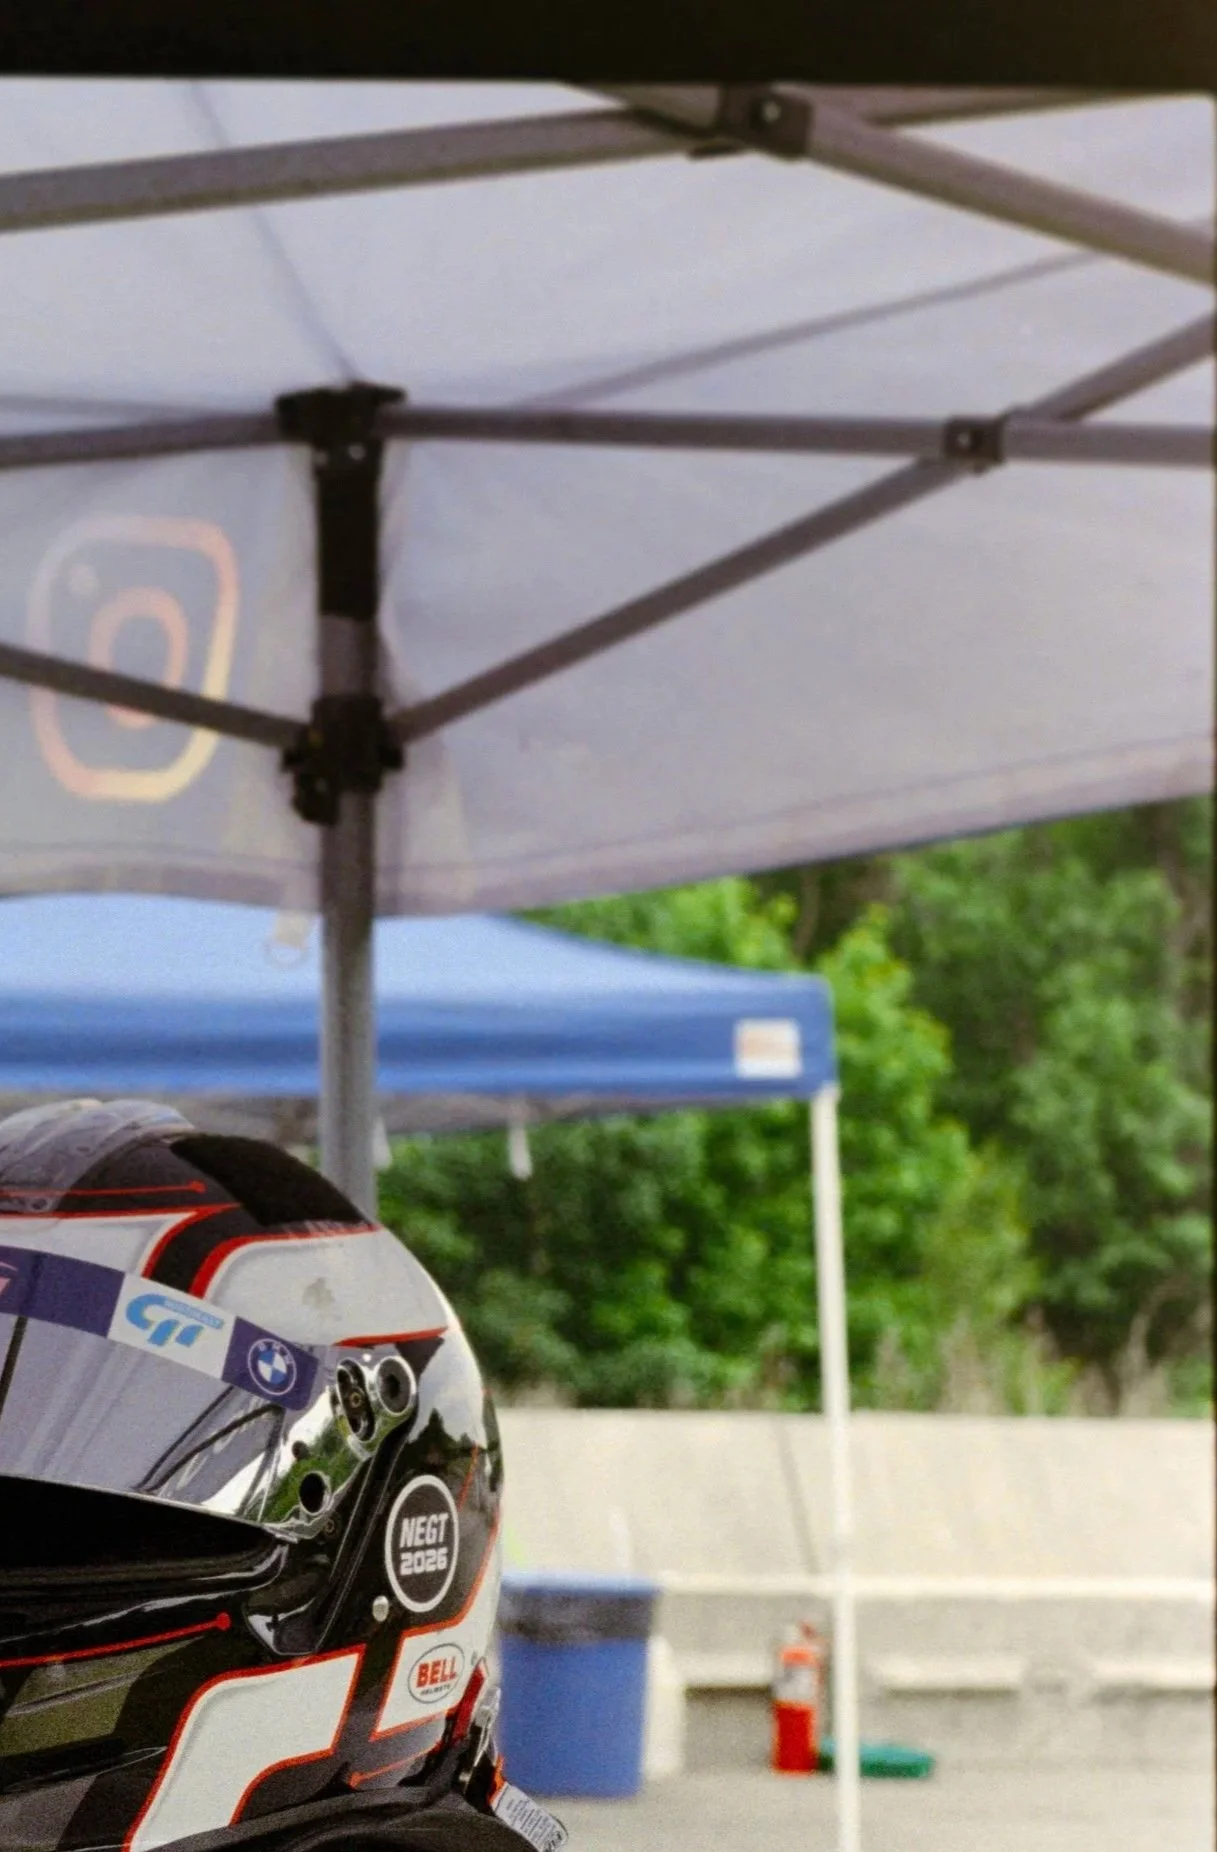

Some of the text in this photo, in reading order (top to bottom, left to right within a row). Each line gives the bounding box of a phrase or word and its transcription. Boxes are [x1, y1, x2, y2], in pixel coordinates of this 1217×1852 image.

[399, 1512, 449, 1548] NEGT
[399, 1547, 449, 1577] 2026
[415, 1655, 458, 1688] BELL
